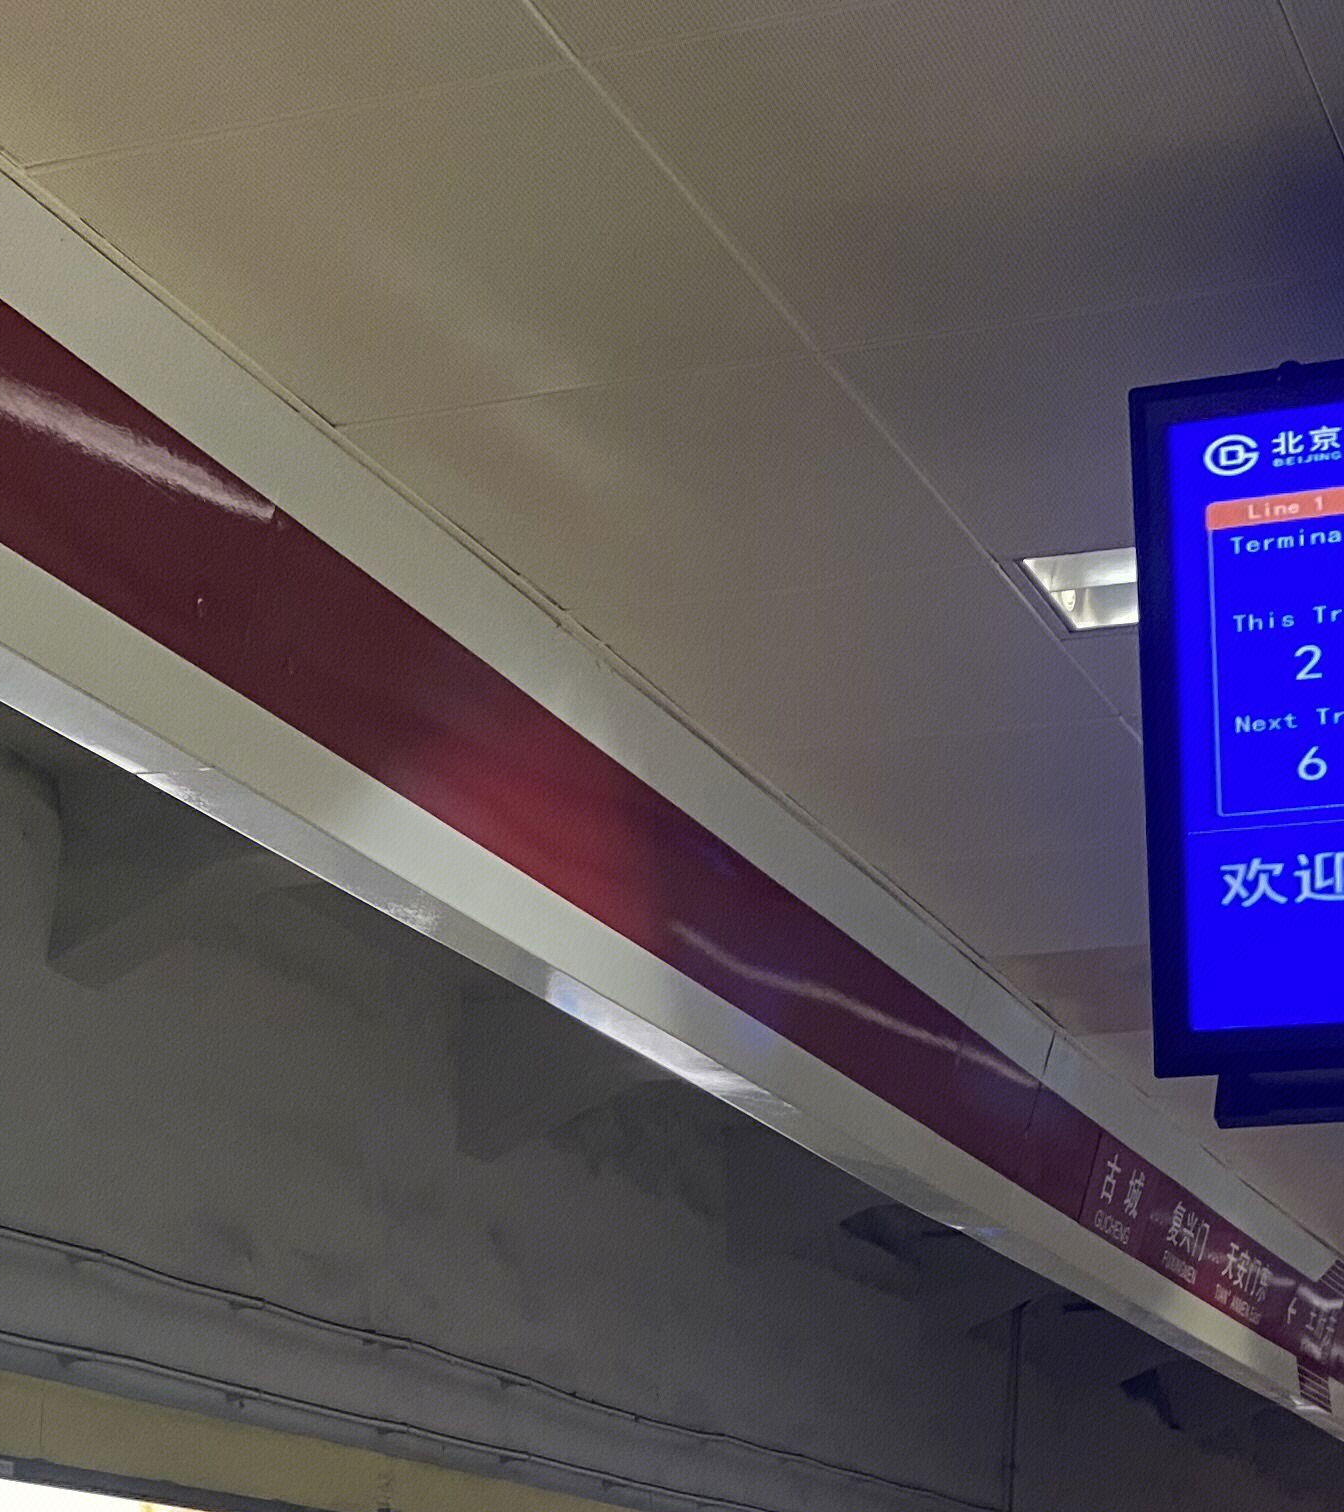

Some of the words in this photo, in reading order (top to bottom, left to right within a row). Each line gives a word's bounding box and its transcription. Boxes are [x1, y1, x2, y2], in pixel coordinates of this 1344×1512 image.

[1272, 451, 1342, 467] BEIJING
[1247, 501, 1300, 520] Line
[1314, 496, 1324, 511] 1
[1233, 611, 1295, 633] This
[1294, 644, 1323, 681] 2
[1235, 711, 1298, 735] Next
[1297, 746, 1327, 781] 6
